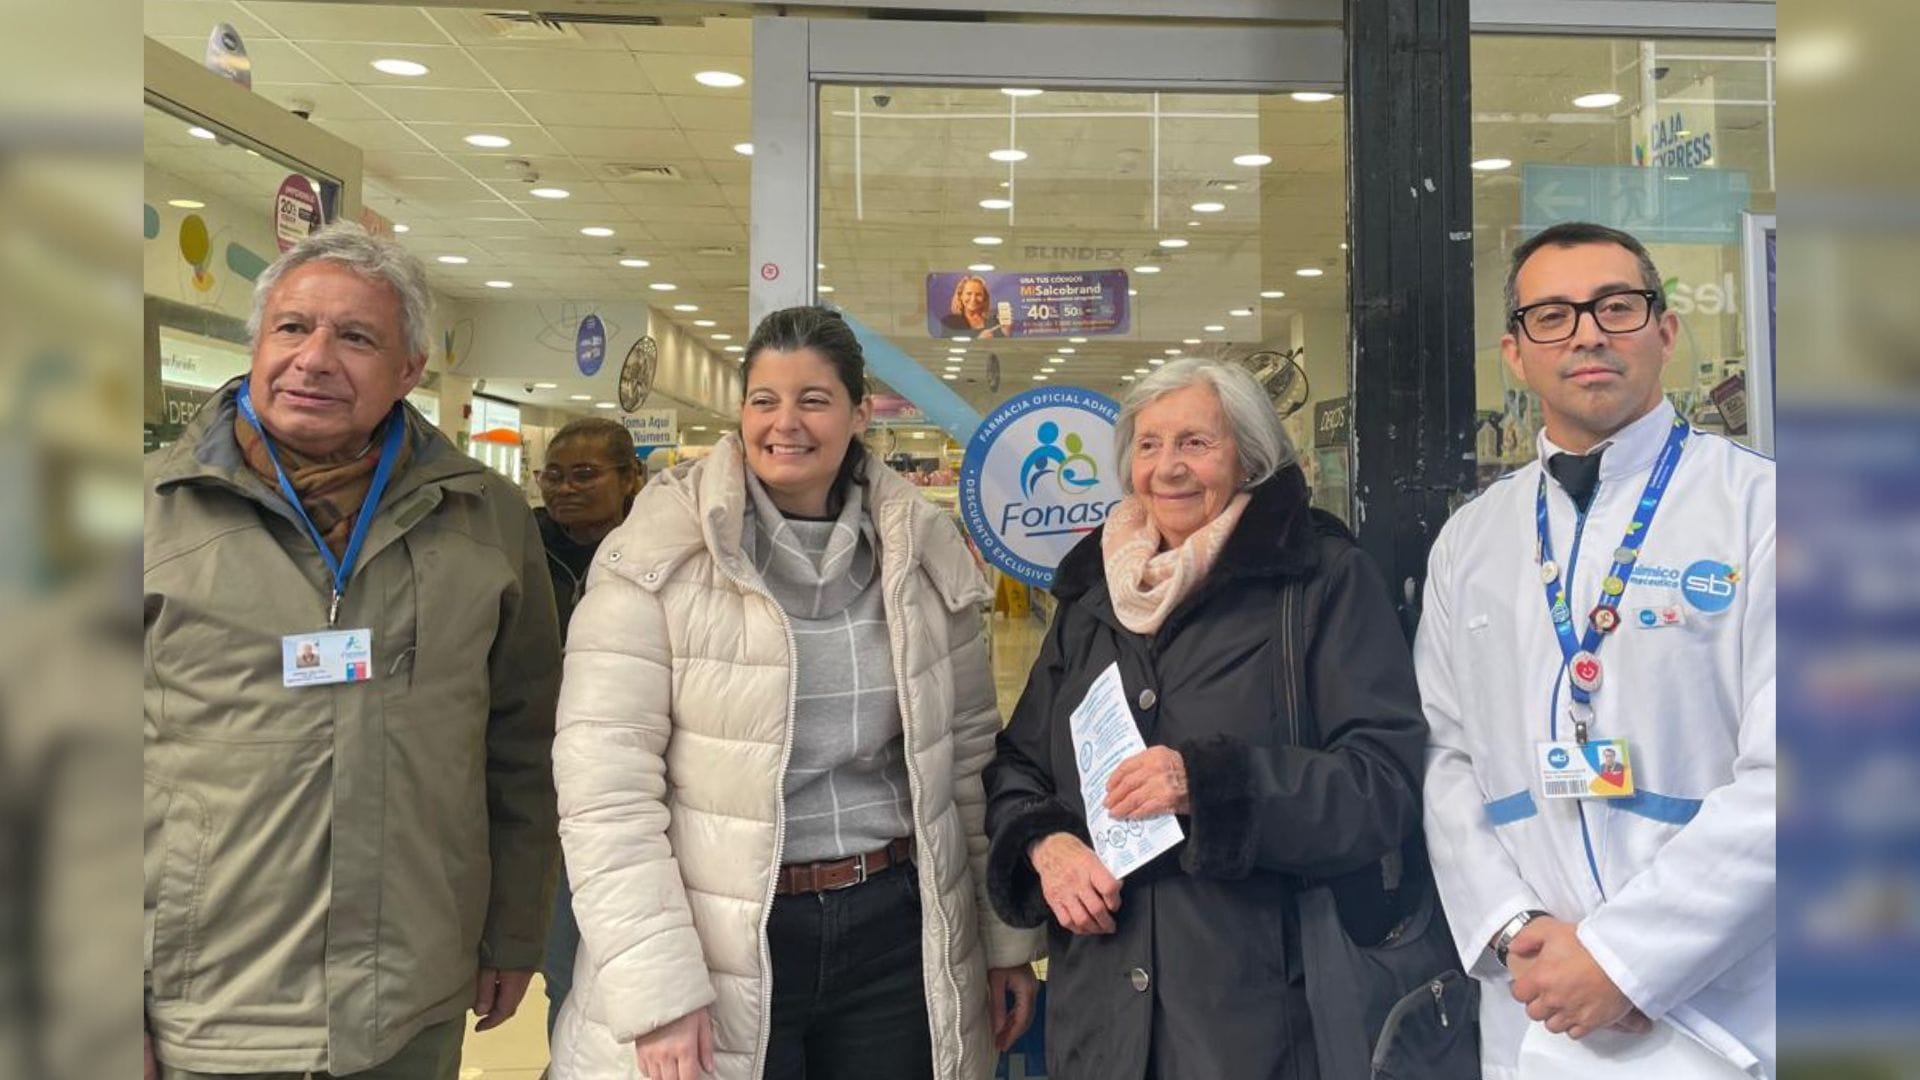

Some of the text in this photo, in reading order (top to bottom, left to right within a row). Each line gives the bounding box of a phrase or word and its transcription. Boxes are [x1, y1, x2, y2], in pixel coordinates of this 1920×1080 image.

[1652, 112, 1683, 151] CAJA
[1024, 246, 1125, 259] BLINDEX
[1036, 276, 1050, 284] TUS
[978, 401, 1031, 443] FARMACIA
[1033, 393, 1080, 405] OFICIAL
[965, 479, 1053, 582] DESCUENTO EXCLUSIVO
[1686, 573, 1732, 597] sb
